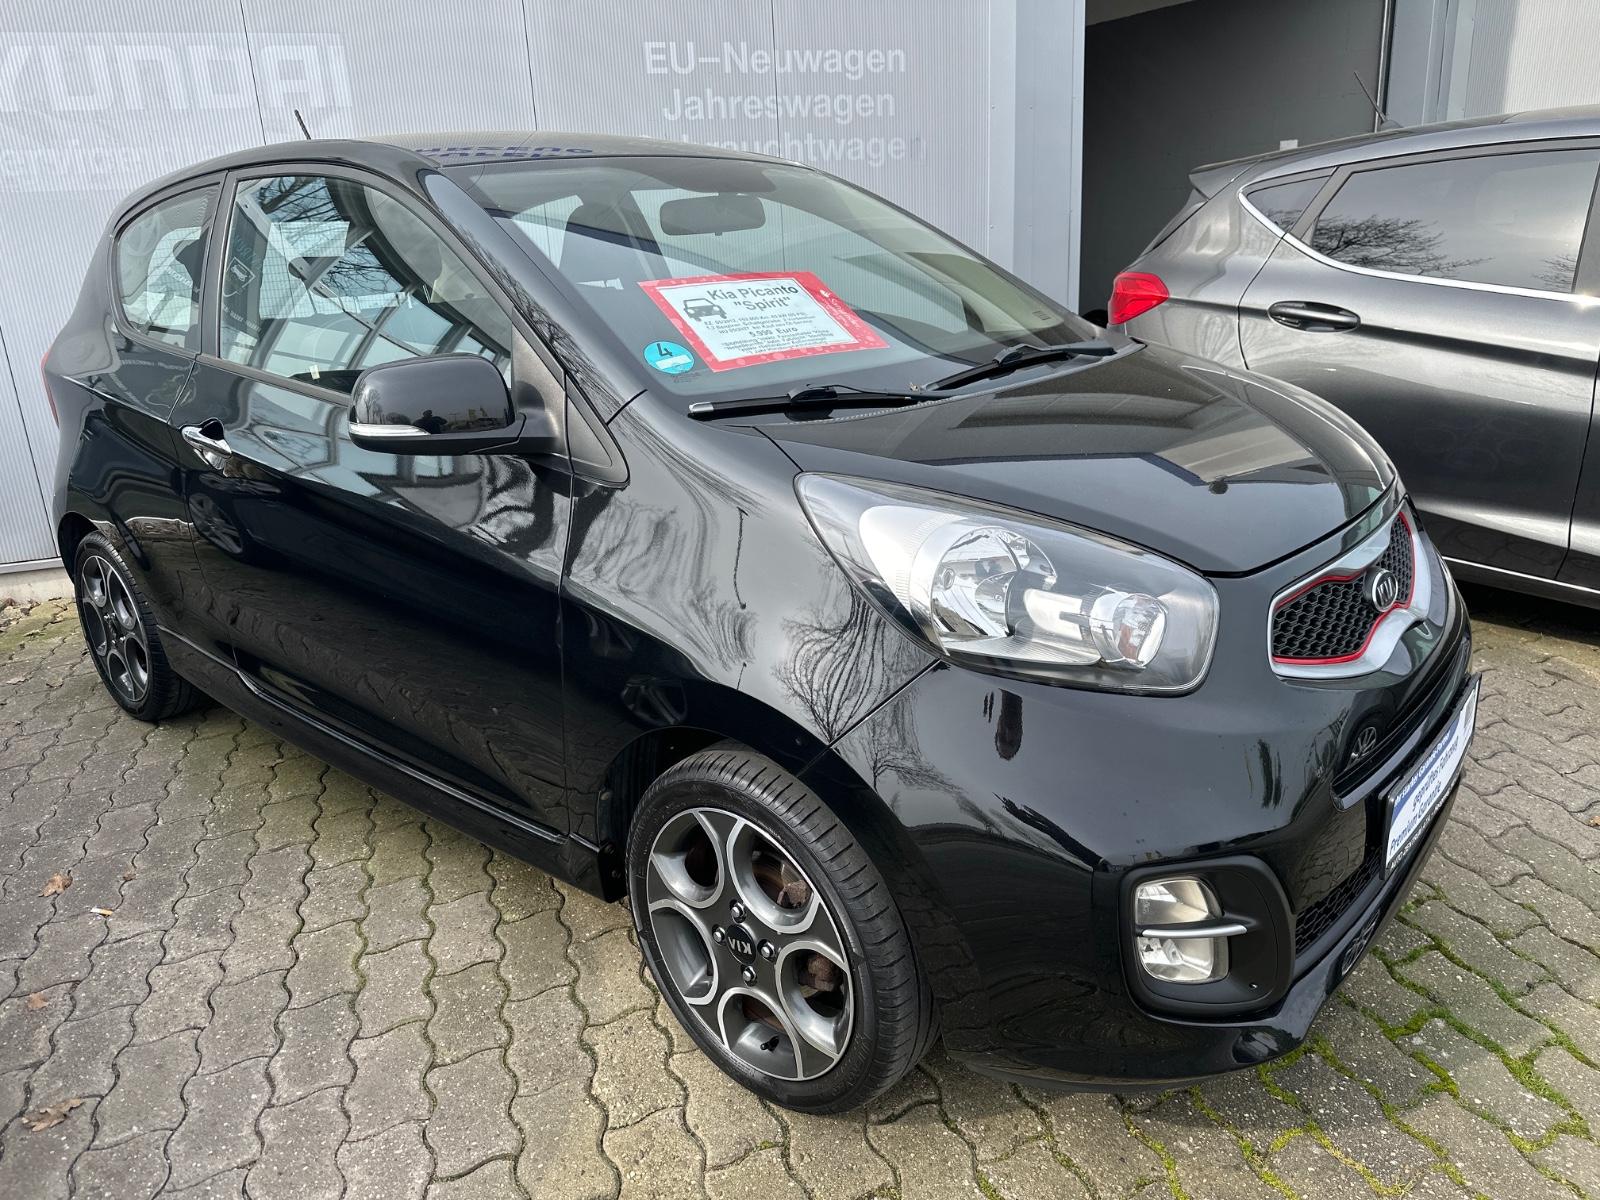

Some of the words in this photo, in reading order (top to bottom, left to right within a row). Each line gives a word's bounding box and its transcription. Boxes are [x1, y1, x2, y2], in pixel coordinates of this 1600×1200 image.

[643, 40, 907, 81] EU-Neuwagen
[662, 87, 896, 125] Jahreswagen
[707, 289, 738, 302] Kia
[741, 284, 799, 299] Picanto
[734, 296, 792, 312] "Spirit"
[656, 343, 673, 356] 4
[1389, 812, 1419, 854] Premium
[727, 936, 752, 955] KIA
